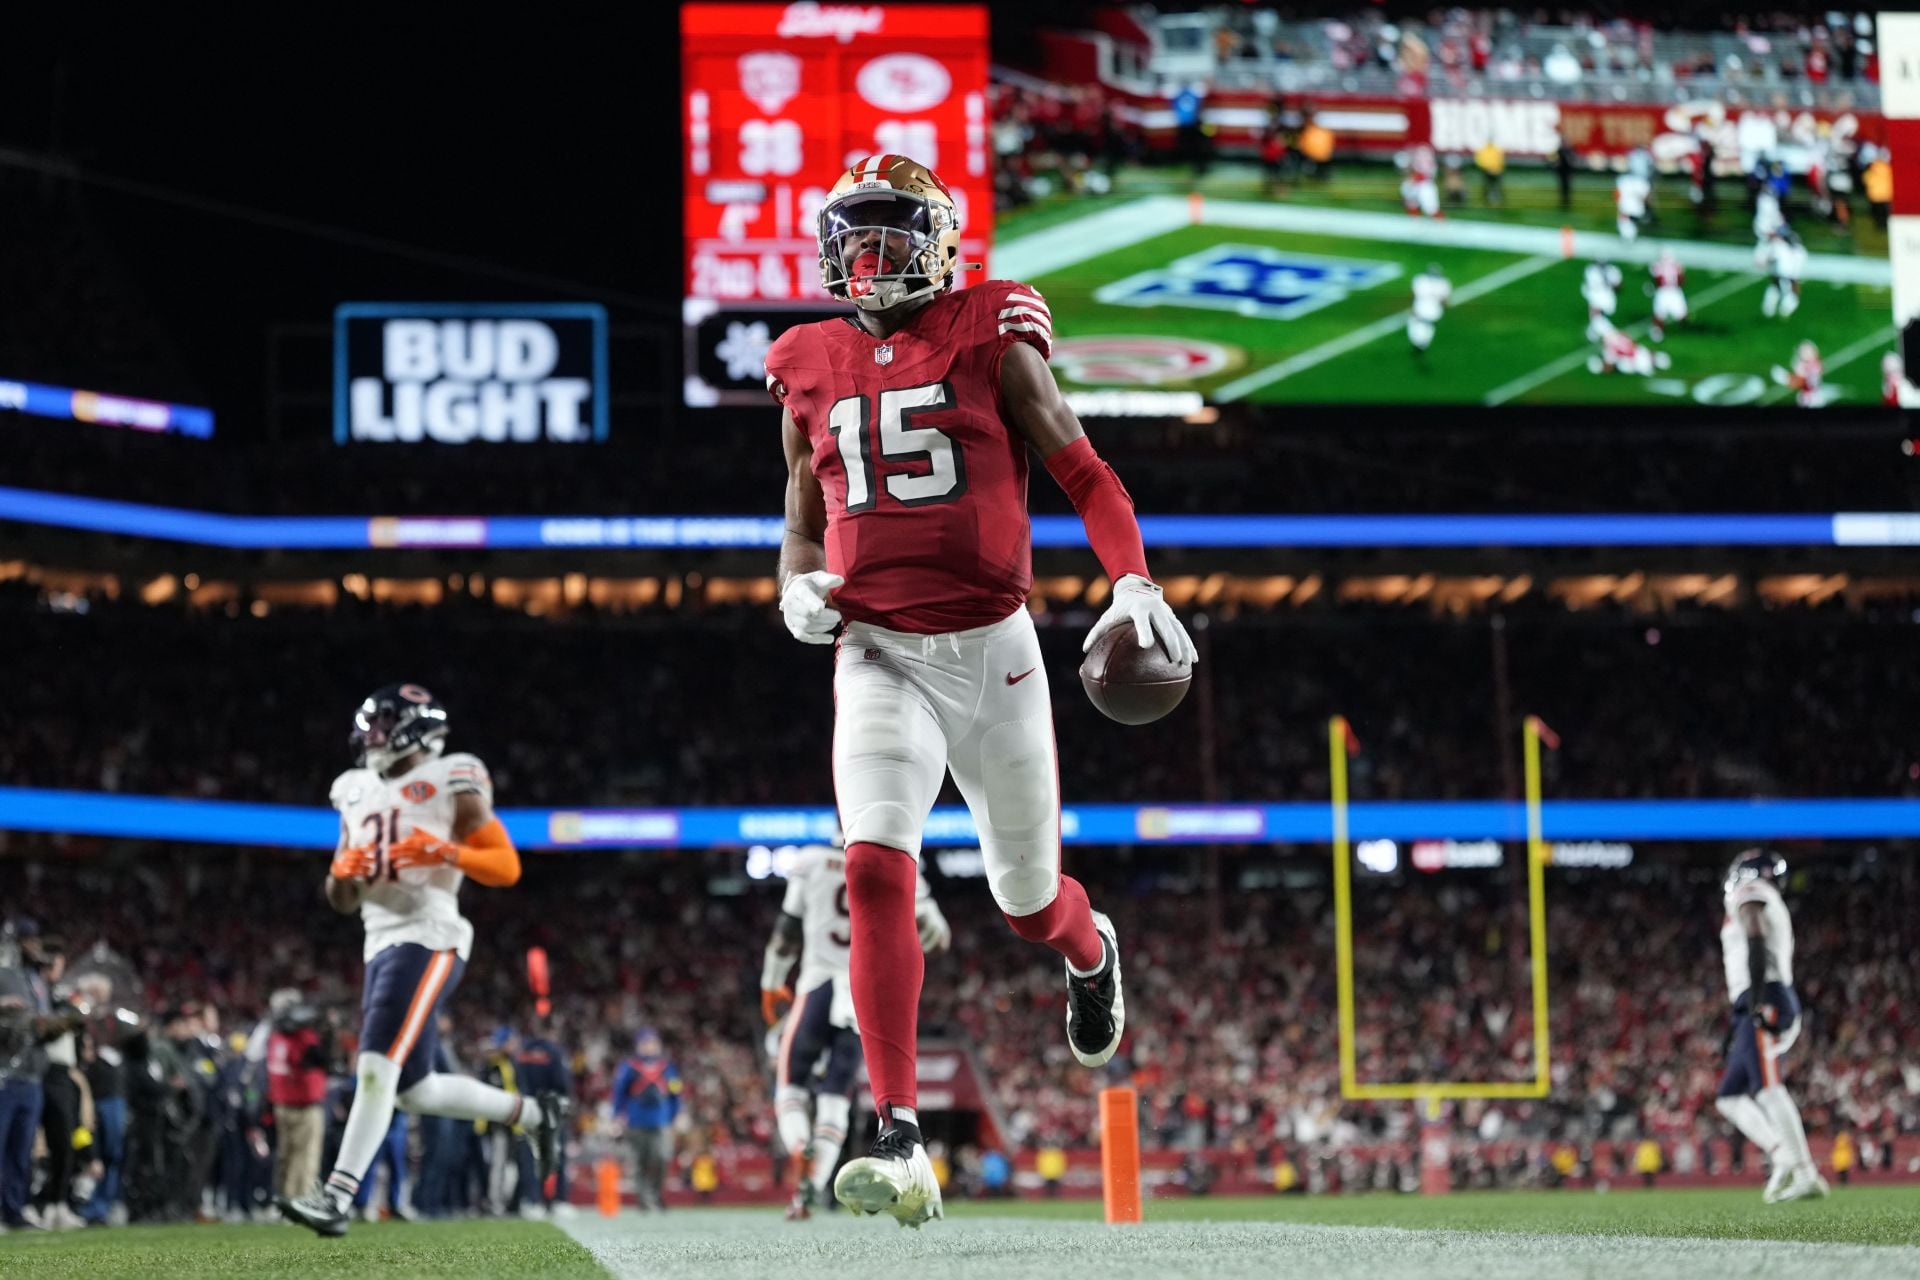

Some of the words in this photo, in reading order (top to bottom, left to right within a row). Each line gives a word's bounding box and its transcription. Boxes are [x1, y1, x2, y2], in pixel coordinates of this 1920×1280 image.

[383, 319, 559, 382] BUD
[350, 377, 592, 443] LIGHT
[829, 383, 967, 513] 15
